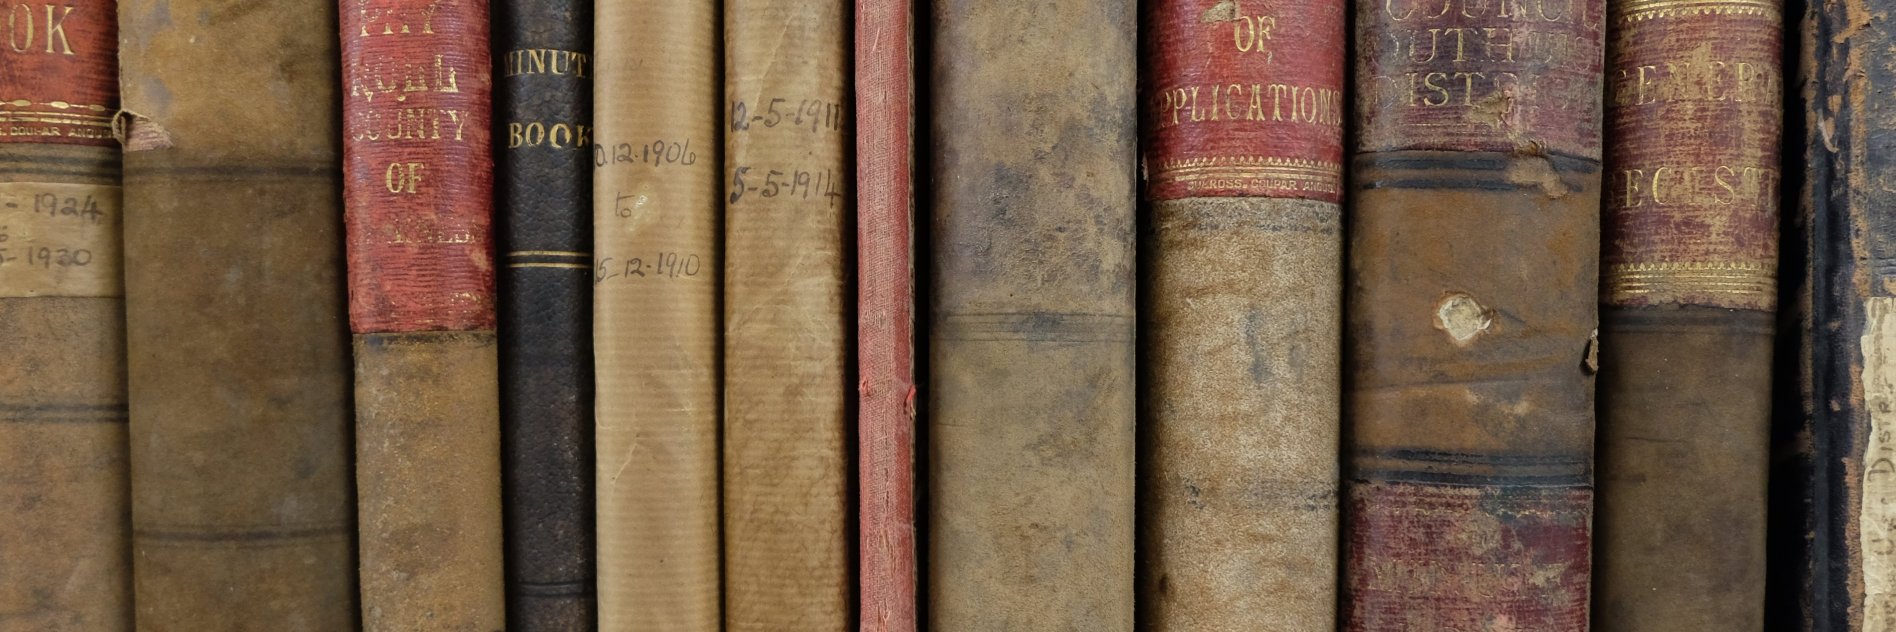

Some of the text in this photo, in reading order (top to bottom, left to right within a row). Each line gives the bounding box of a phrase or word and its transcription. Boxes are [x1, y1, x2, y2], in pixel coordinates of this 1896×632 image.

[0, 3, 75, 55] OK
[1233, 15, 1276, 52] OF
[507, 121, 593, 150] BOOK
[385, 161, 425, 194] OF
[1250, 179, 1298, 191] COUPAR
